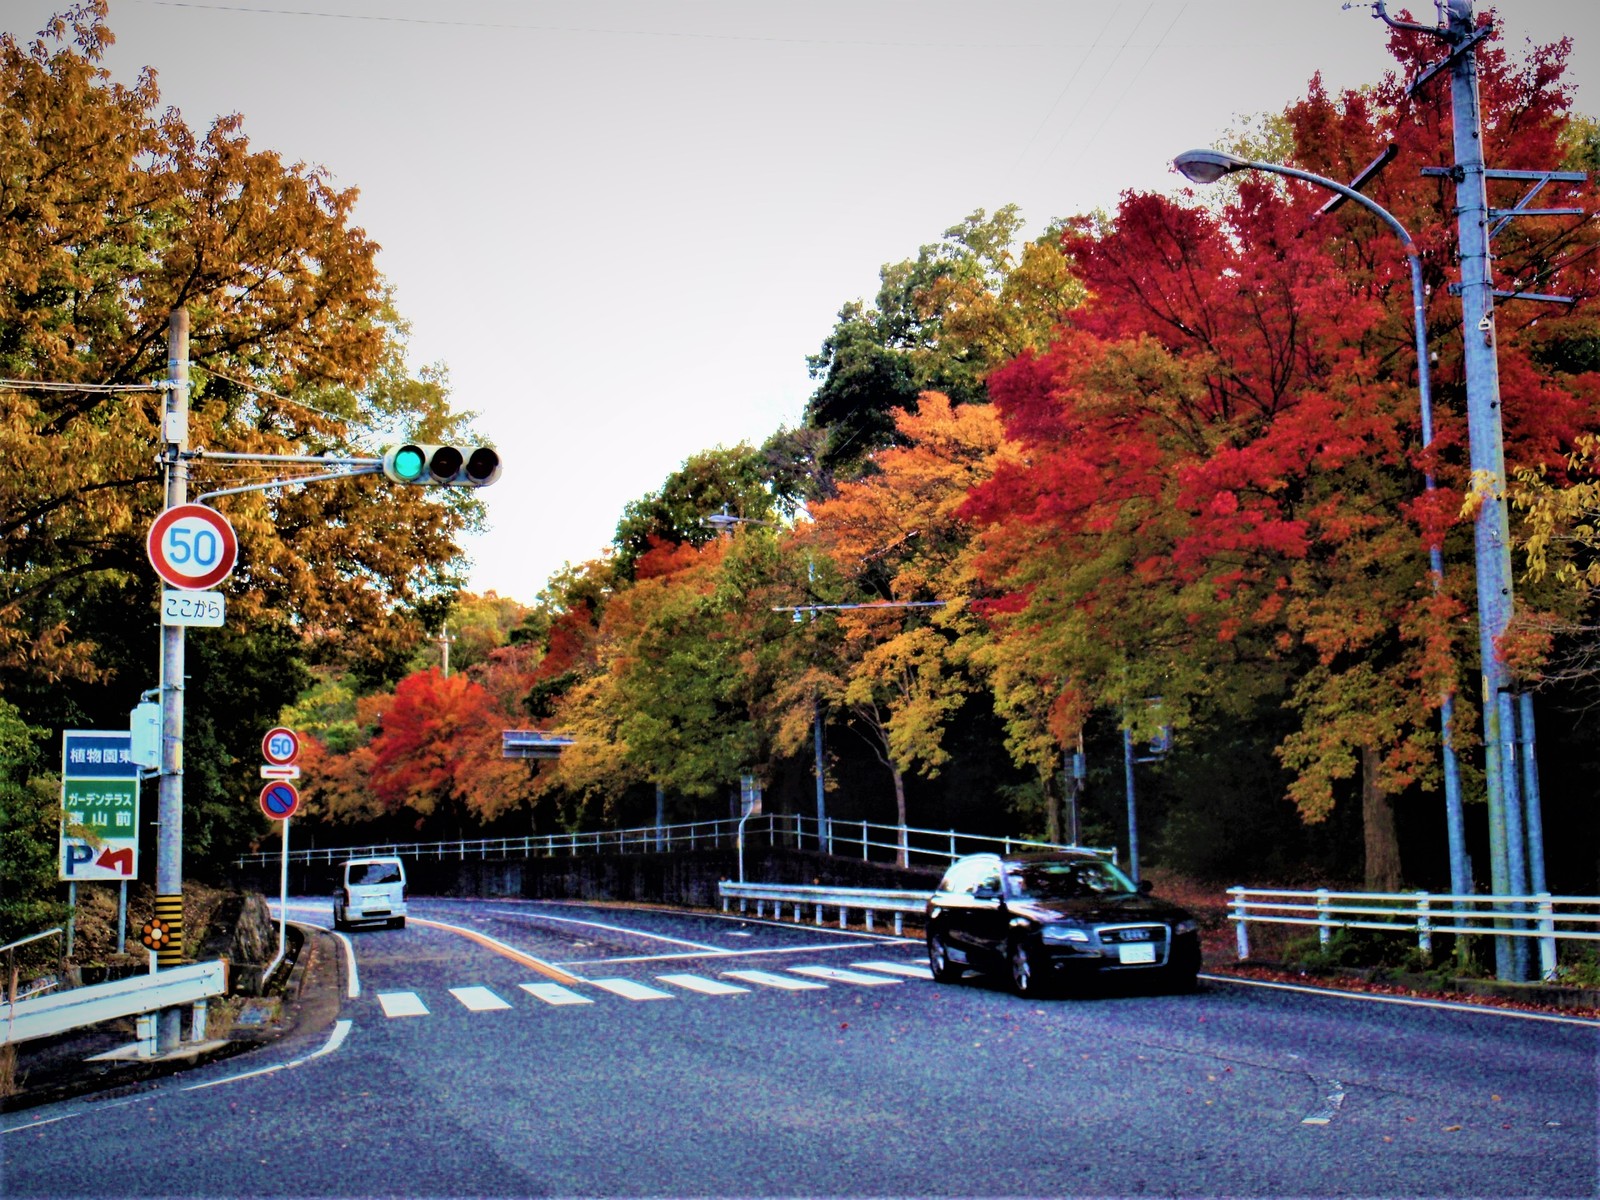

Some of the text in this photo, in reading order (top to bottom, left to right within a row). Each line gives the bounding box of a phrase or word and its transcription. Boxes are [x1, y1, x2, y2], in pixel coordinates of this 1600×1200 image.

[169, 527, 216, 566] 50
[166, 598, 220, 619] ここから
[270, 738, 291, 755] 50
[68, 793, 132, 806] ガーデンテラス
[66, 845, 94, 875] P
